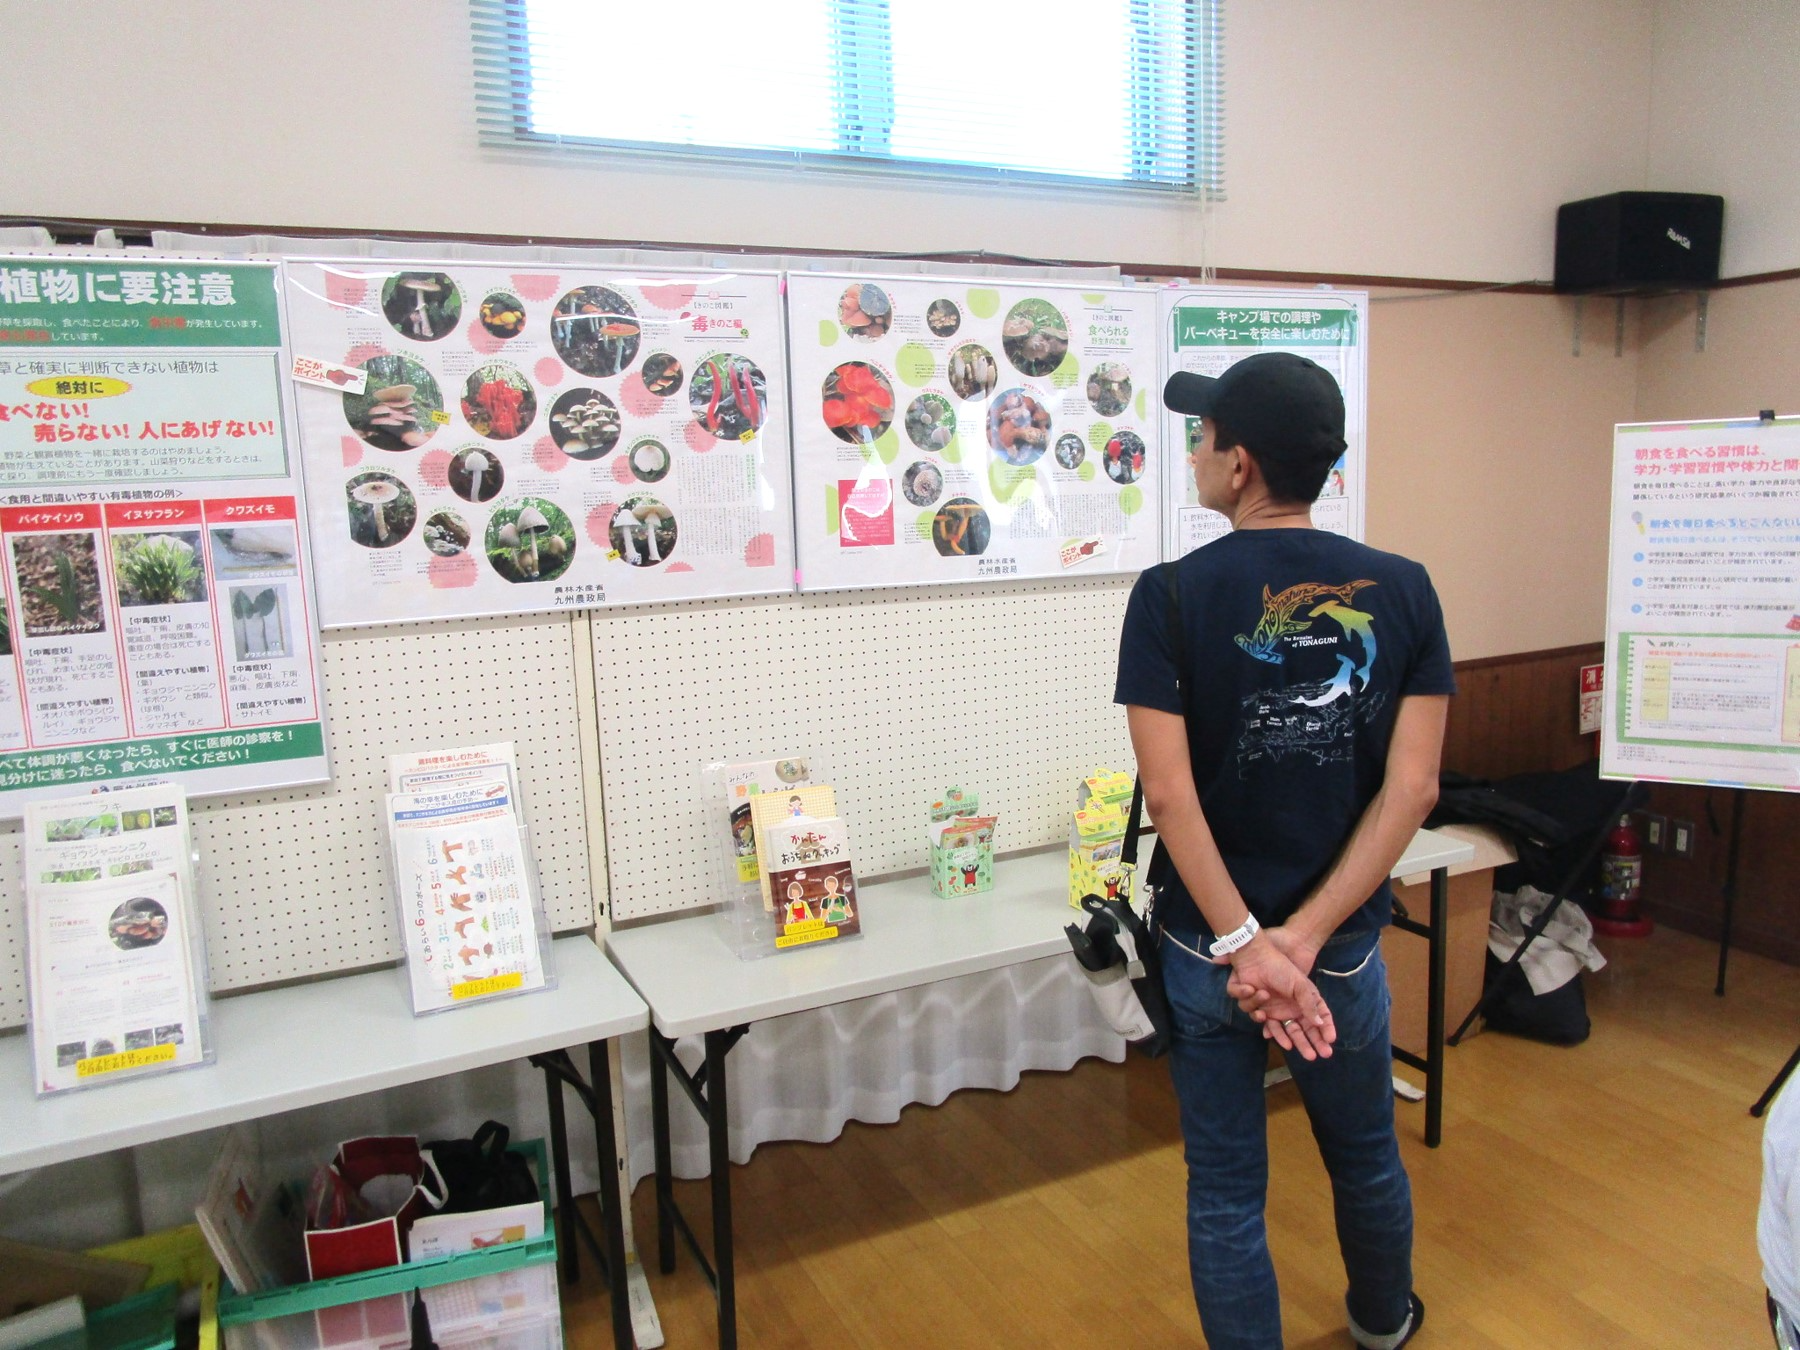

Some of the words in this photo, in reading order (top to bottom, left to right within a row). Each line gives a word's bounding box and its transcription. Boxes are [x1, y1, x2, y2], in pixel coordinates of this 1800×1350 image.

[0, 267, 237, 306] 植物に要注意
[1216, 310, 1321, 325] キャンプ場での調理や
[1088, 325, 1129, 336] 食べられる
[1184, 326, 1350, 341] バーベキューを安全に楽しむために
[296, 357, 323, 370] ここが
[293, 366, 326, 379] ポイント
[55, 381, 104, 394] 絶対に
[33, 422, 130, 443] 売らない!
[138, 419, 275, 440] 人にあげない!
[1634, 458, 1800, 476] 学力・学習習慣や体力と関
[123, 508, 185, 521] イヌサフラン
[225, 503, 276, 516] クワズイモ
[19, 511, 84, 524] バイケイソウ
[978, 558, 1016, 566] 農林水産省
[1062, 552, 1082, 563] ポイント
[978, 565, 1018, 575] 九州農政局
[554, 583, 604, 594] 農林水産省
[554, 592, 606, 605] 九州農政局
[129, 615, 171, 625] 【中毒症状】
[232, 663, 272, 673] 【中毒症状】
[99, 802, 121, 812] フキ
